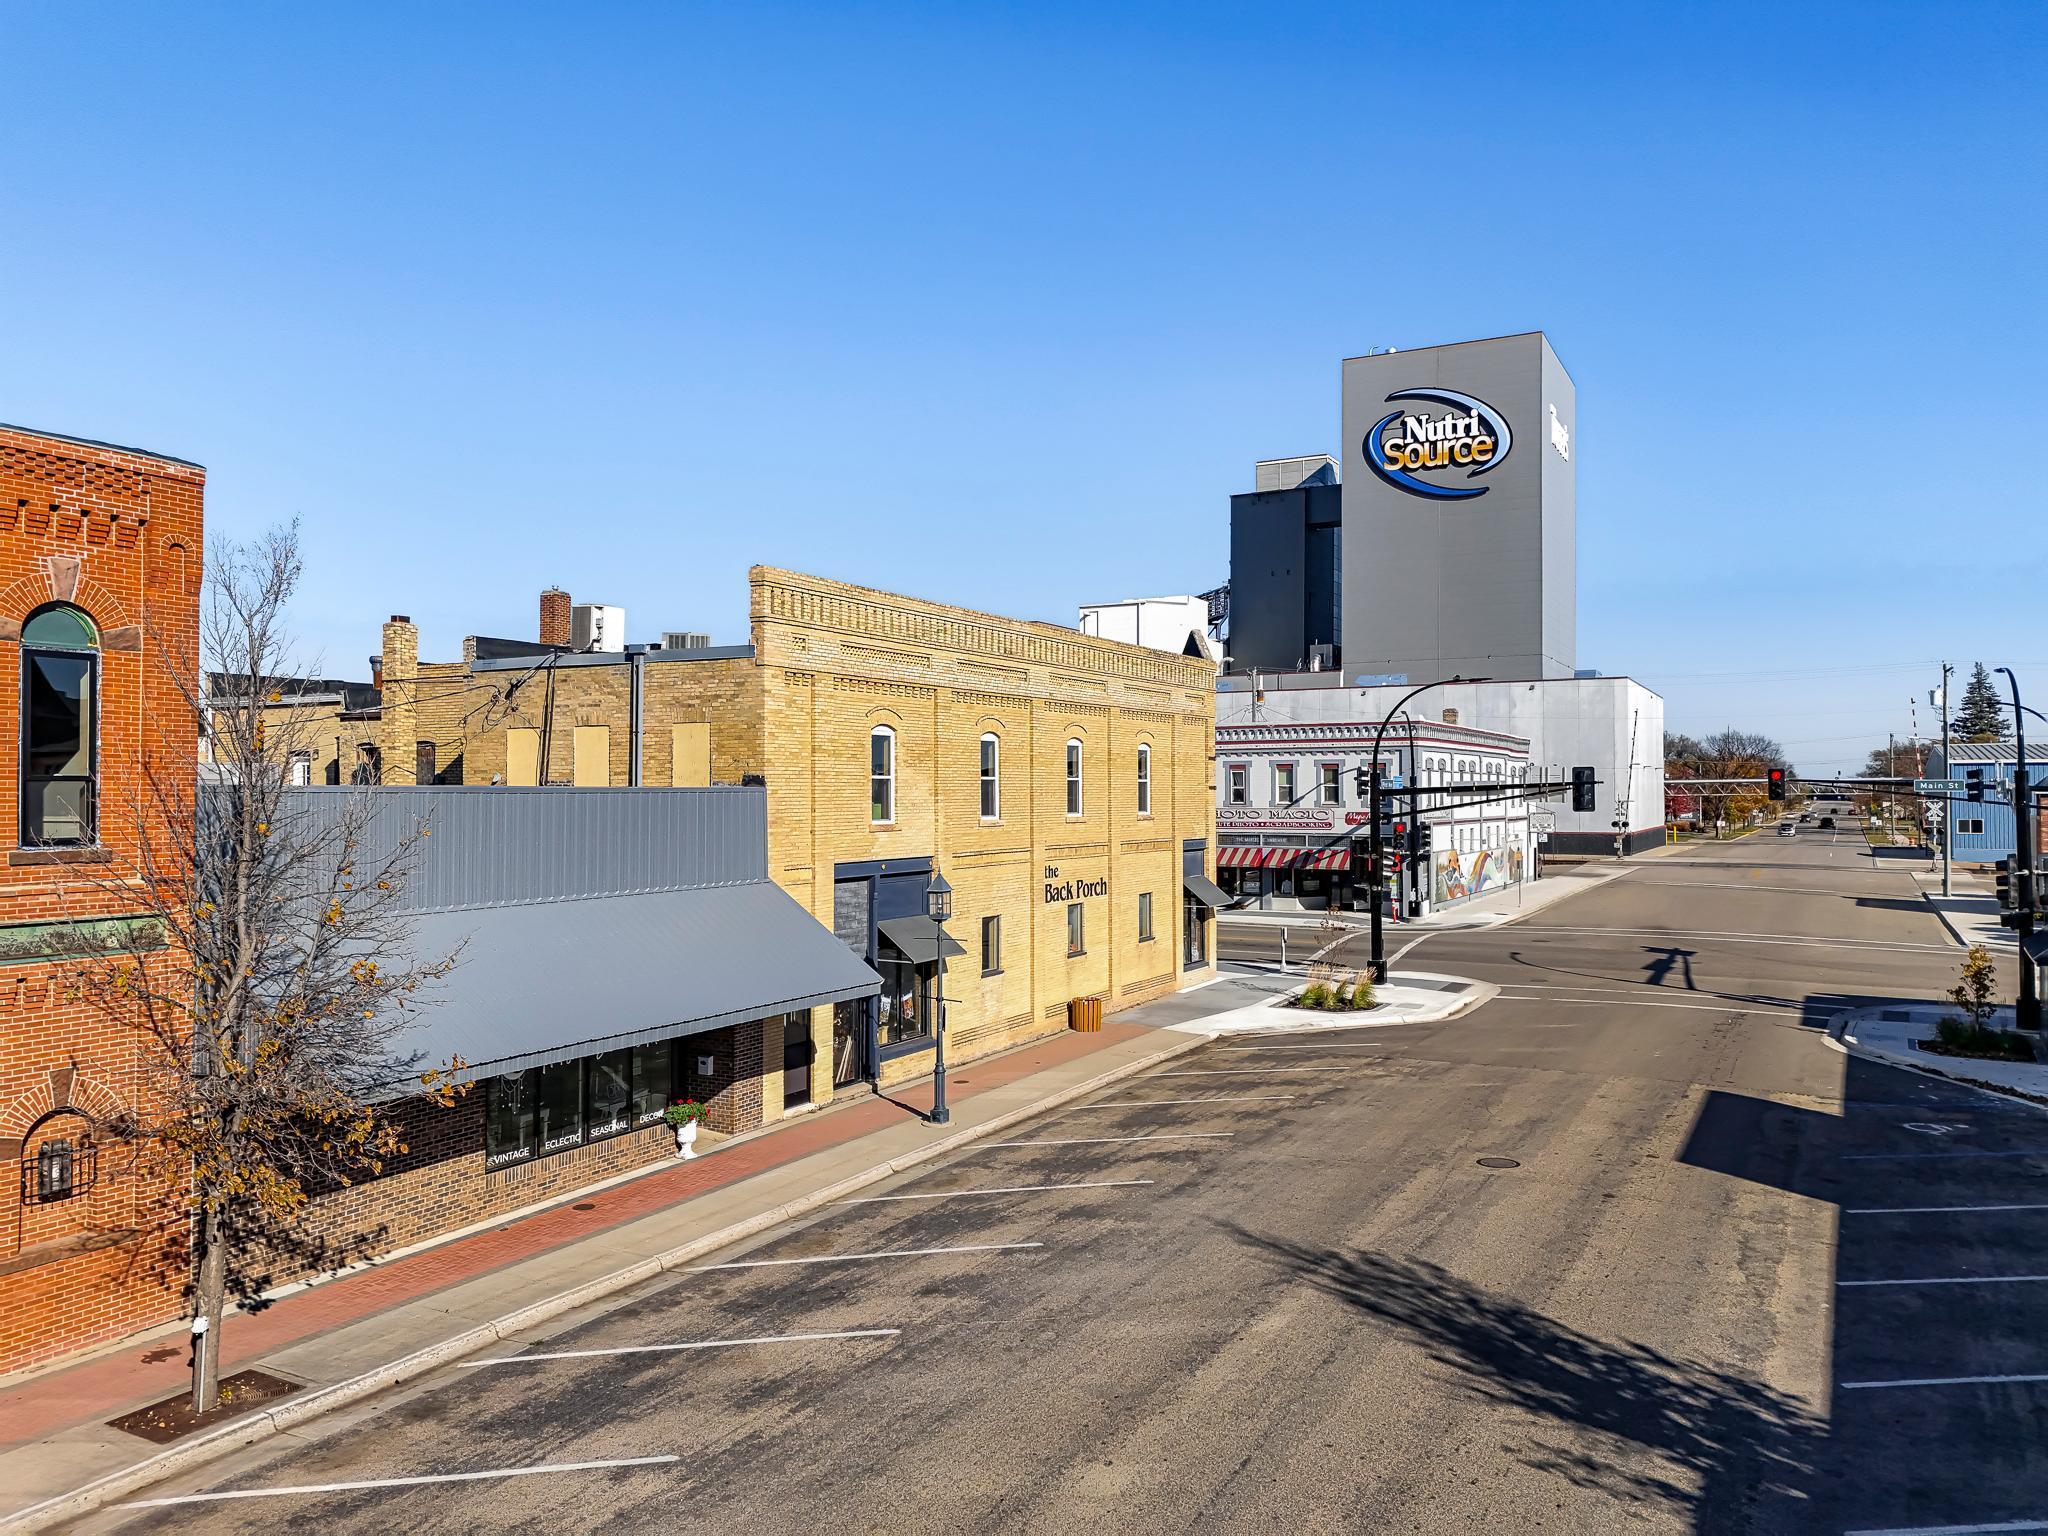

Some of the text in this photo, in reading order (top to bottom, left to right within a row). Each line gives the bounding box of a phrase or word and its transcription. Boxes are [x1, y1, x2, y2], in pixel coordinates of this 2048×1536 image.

[1403, 408, 1481, 444] Nutri
[1383, 434, 1493, 471] Source
[1269, 810, 1330, 820] MAGIC
[1045, 865, 1059, 879] the
[1045, 877, 1107, 903] Back Porch
[494, 1108, 664, 1164] VINTAGE ECLECTIC SEASONAL DECOR
